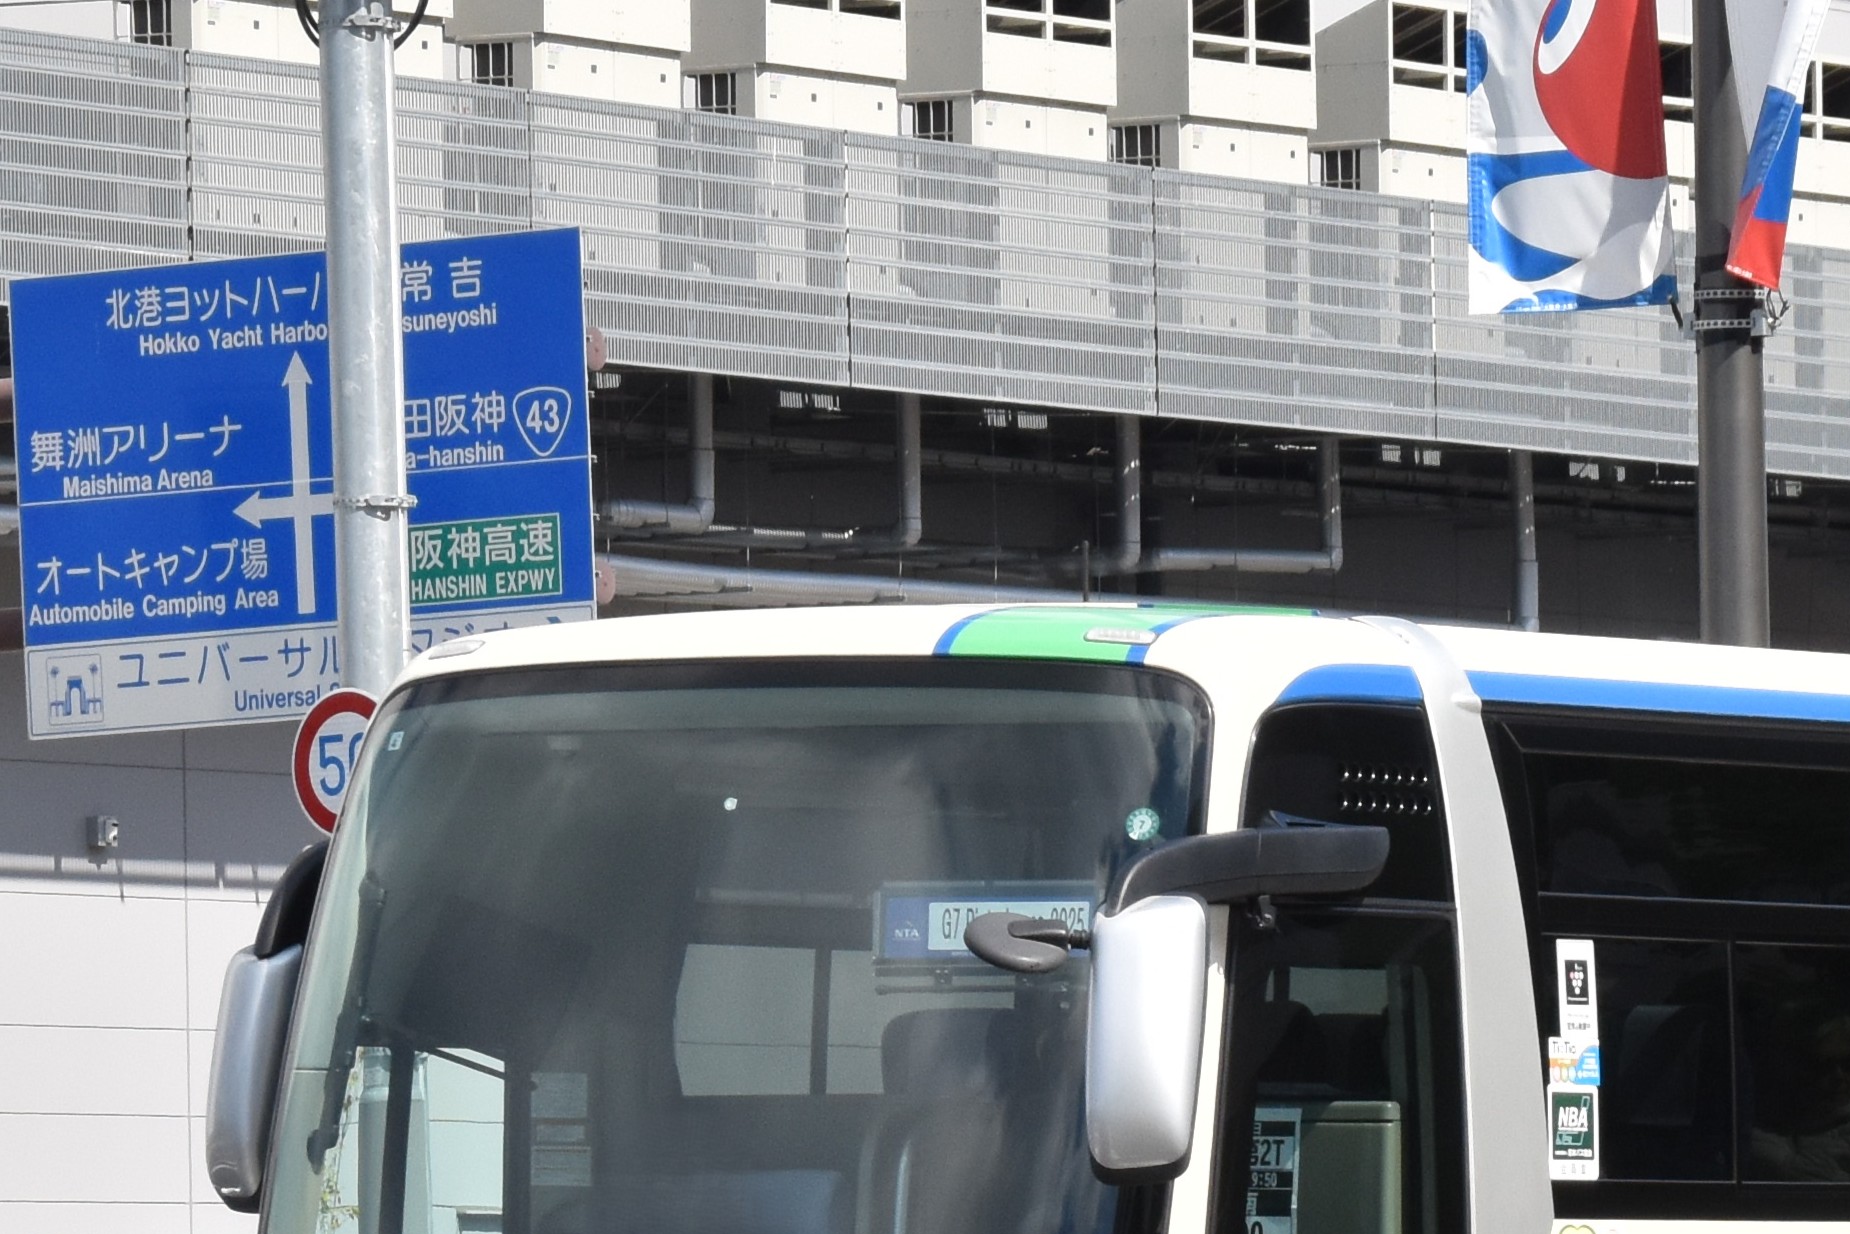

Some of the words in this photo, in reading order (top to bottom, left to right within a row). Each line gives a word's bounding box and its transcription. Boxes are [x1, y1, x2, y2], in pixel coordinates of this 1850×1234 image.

[401, 256, 482, 302] 常吉
[140, 333, 200, 356] Hokko
[208, 327, 263, 350] Yacht
[271, 321, 327, 344] Harbo
[404, 390, 506, 438] 田阪神
[526, 399, 559, 433] 43
[31, 415, 242, 472] 舞洲アリーナ
[64, 473, 152, 498] Maishima
[157, 468, 213, 490] Arena
[410, 519, 554, 573] 阪神高速
[37, 538, 268, 595] オートキャンプ場
[411, 574, 487, 601] HANSHIN
[496, 567, 556, 595] EXPWY
[30, 598, 134, 626] Automobile
[143, 592, 226, 618] Camping
[235, 588, 279, 609] Area
[118, 635, 339, 688] ユニバーサル
[235, 688, 320, 712] Universal
[894, 928, 920, 939] NTA
[941, 907, 960, 940] G7
[1558, 1106, 1588, 1129] NBA
